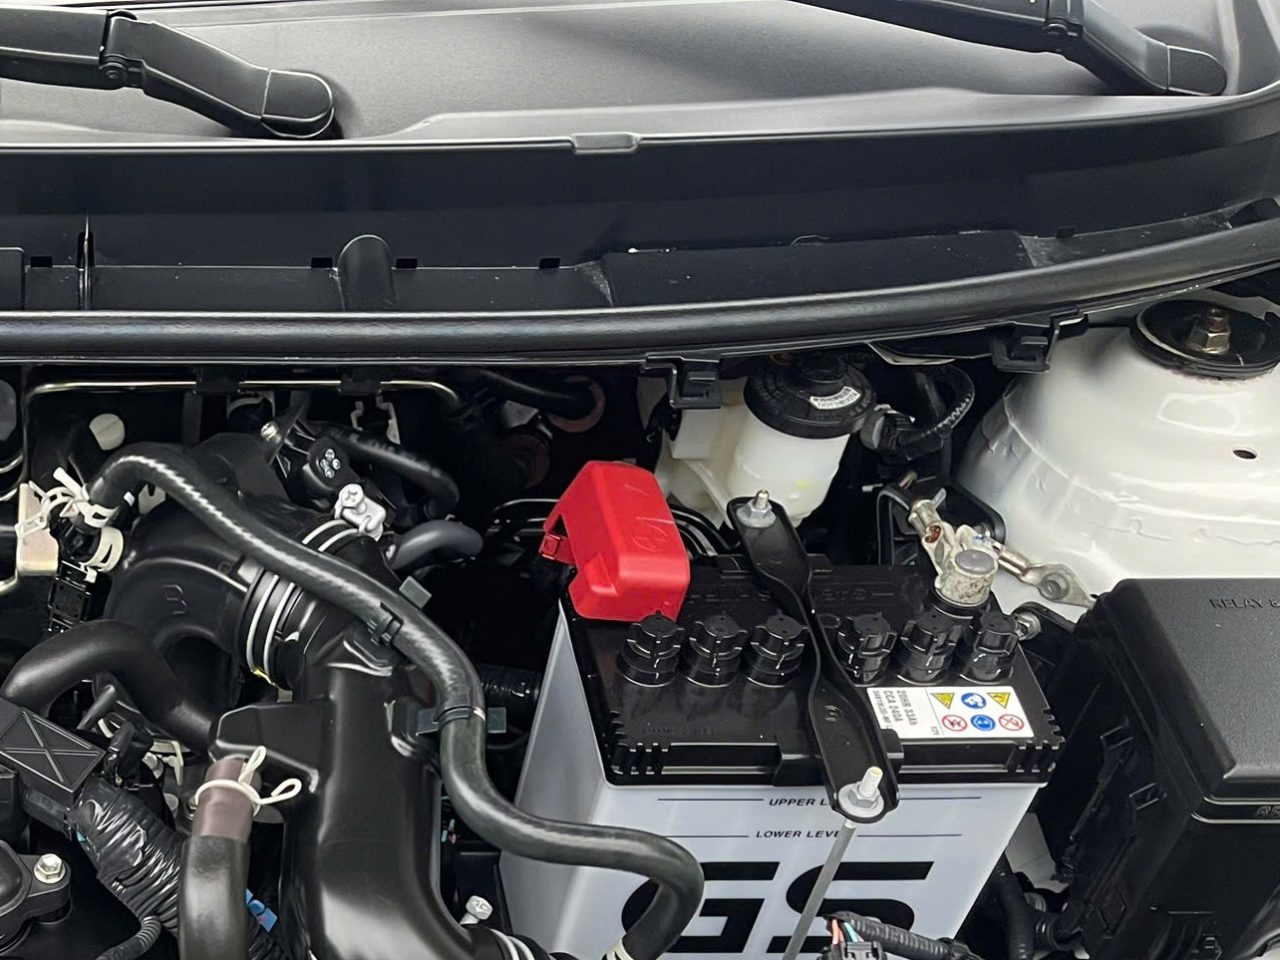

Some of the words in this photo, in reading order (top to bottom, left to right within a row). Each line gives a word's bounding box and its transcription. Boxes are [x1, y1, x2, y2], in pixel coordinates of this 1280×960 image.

[1208, 598, 1263, 609] RELAY
[769, 798, 816, 807] UPPER
[755, 830, 802, 838] LOWER
[621, 860, 935, 954] GS
